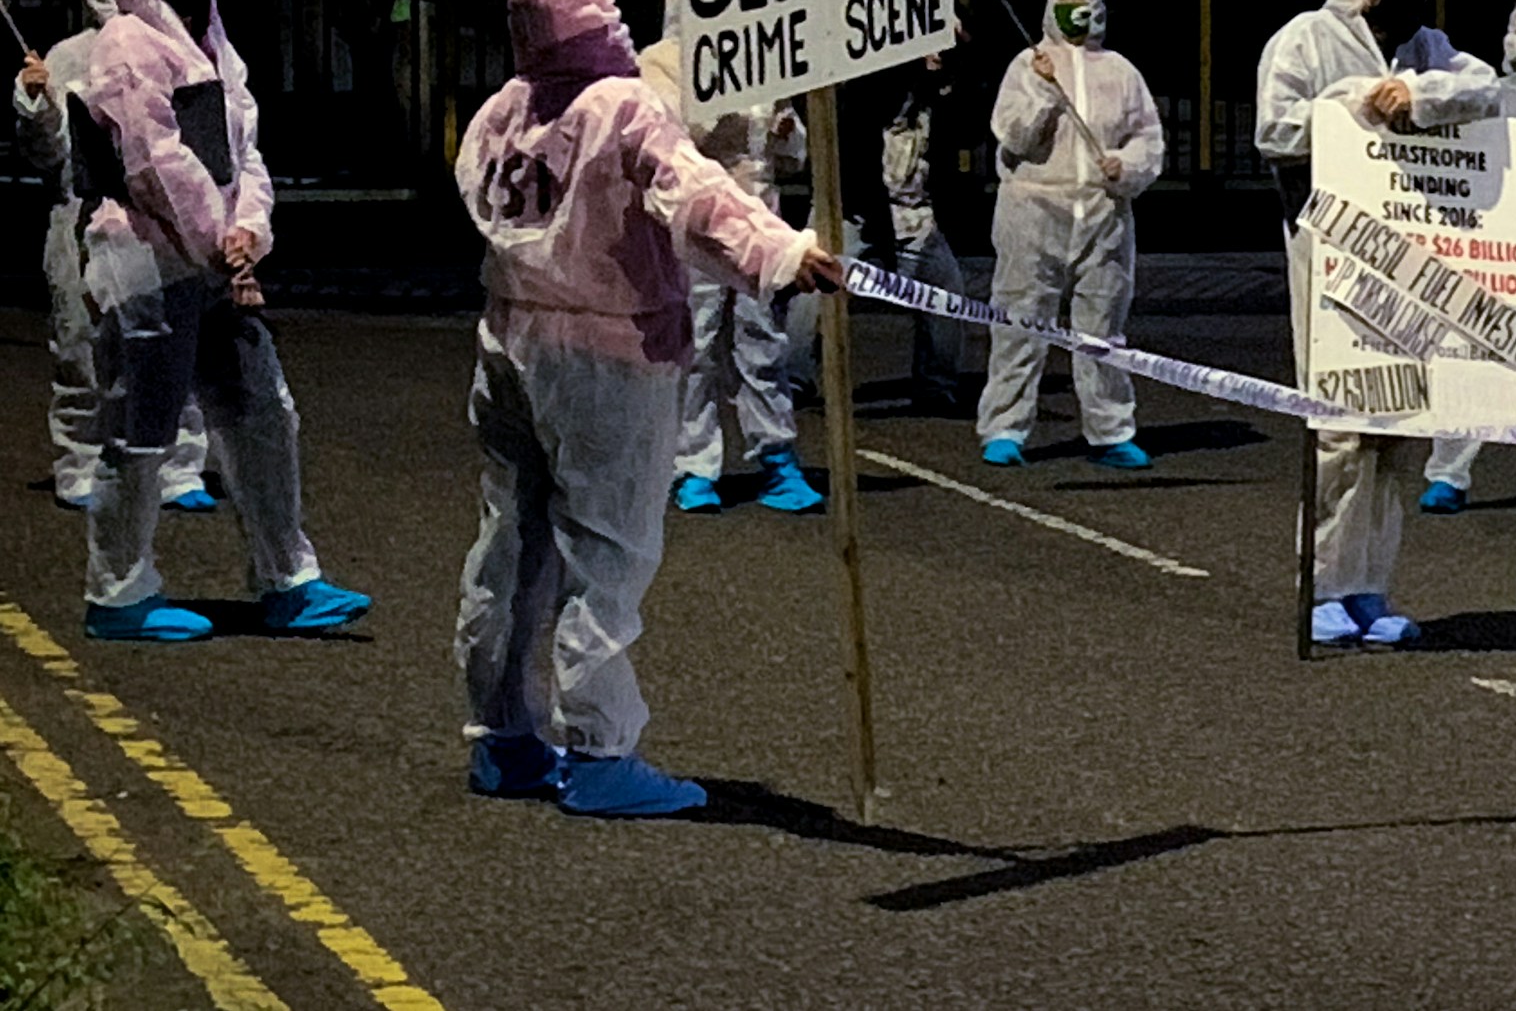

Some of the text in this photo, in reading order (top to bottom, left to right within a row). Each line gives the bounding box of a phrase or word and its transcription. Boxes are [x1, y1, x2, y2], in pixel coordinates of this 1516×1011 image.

[692, 9, 809, 103] CRIME
[1366, 140, 1487, 172] CATASTROPHE
[1389, 171, 1472, 199] FUNDING
[1381, 200, 1484, 230] SINCE 2016:
[1339, 209, 1412, 281] FOSSIL
[1407, 255, 1464, 315] FUEL
